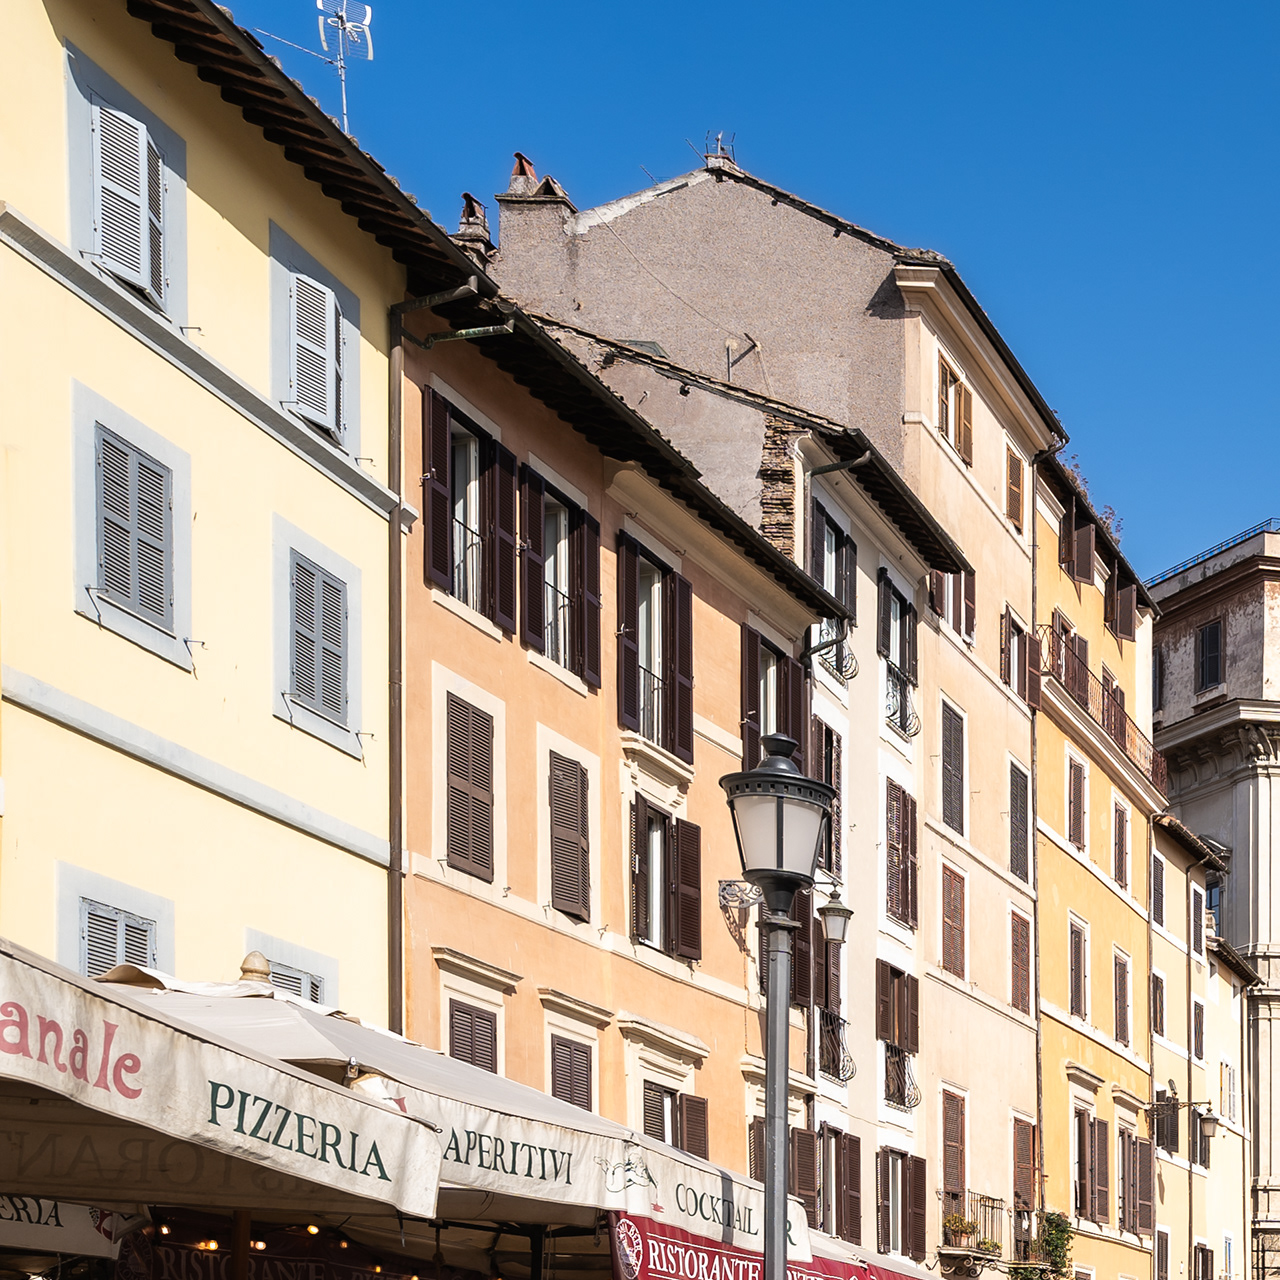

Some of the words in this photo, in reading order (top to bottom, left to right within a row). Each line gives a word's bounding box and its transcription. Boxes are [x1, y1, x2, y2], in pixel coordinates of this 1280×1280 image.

[208, 1080, 392, 1182] PIZZERIA
[443, 1127, 572, 1185] APERITIVI
[675, 1183, 759, 1236] COCKTAIL
